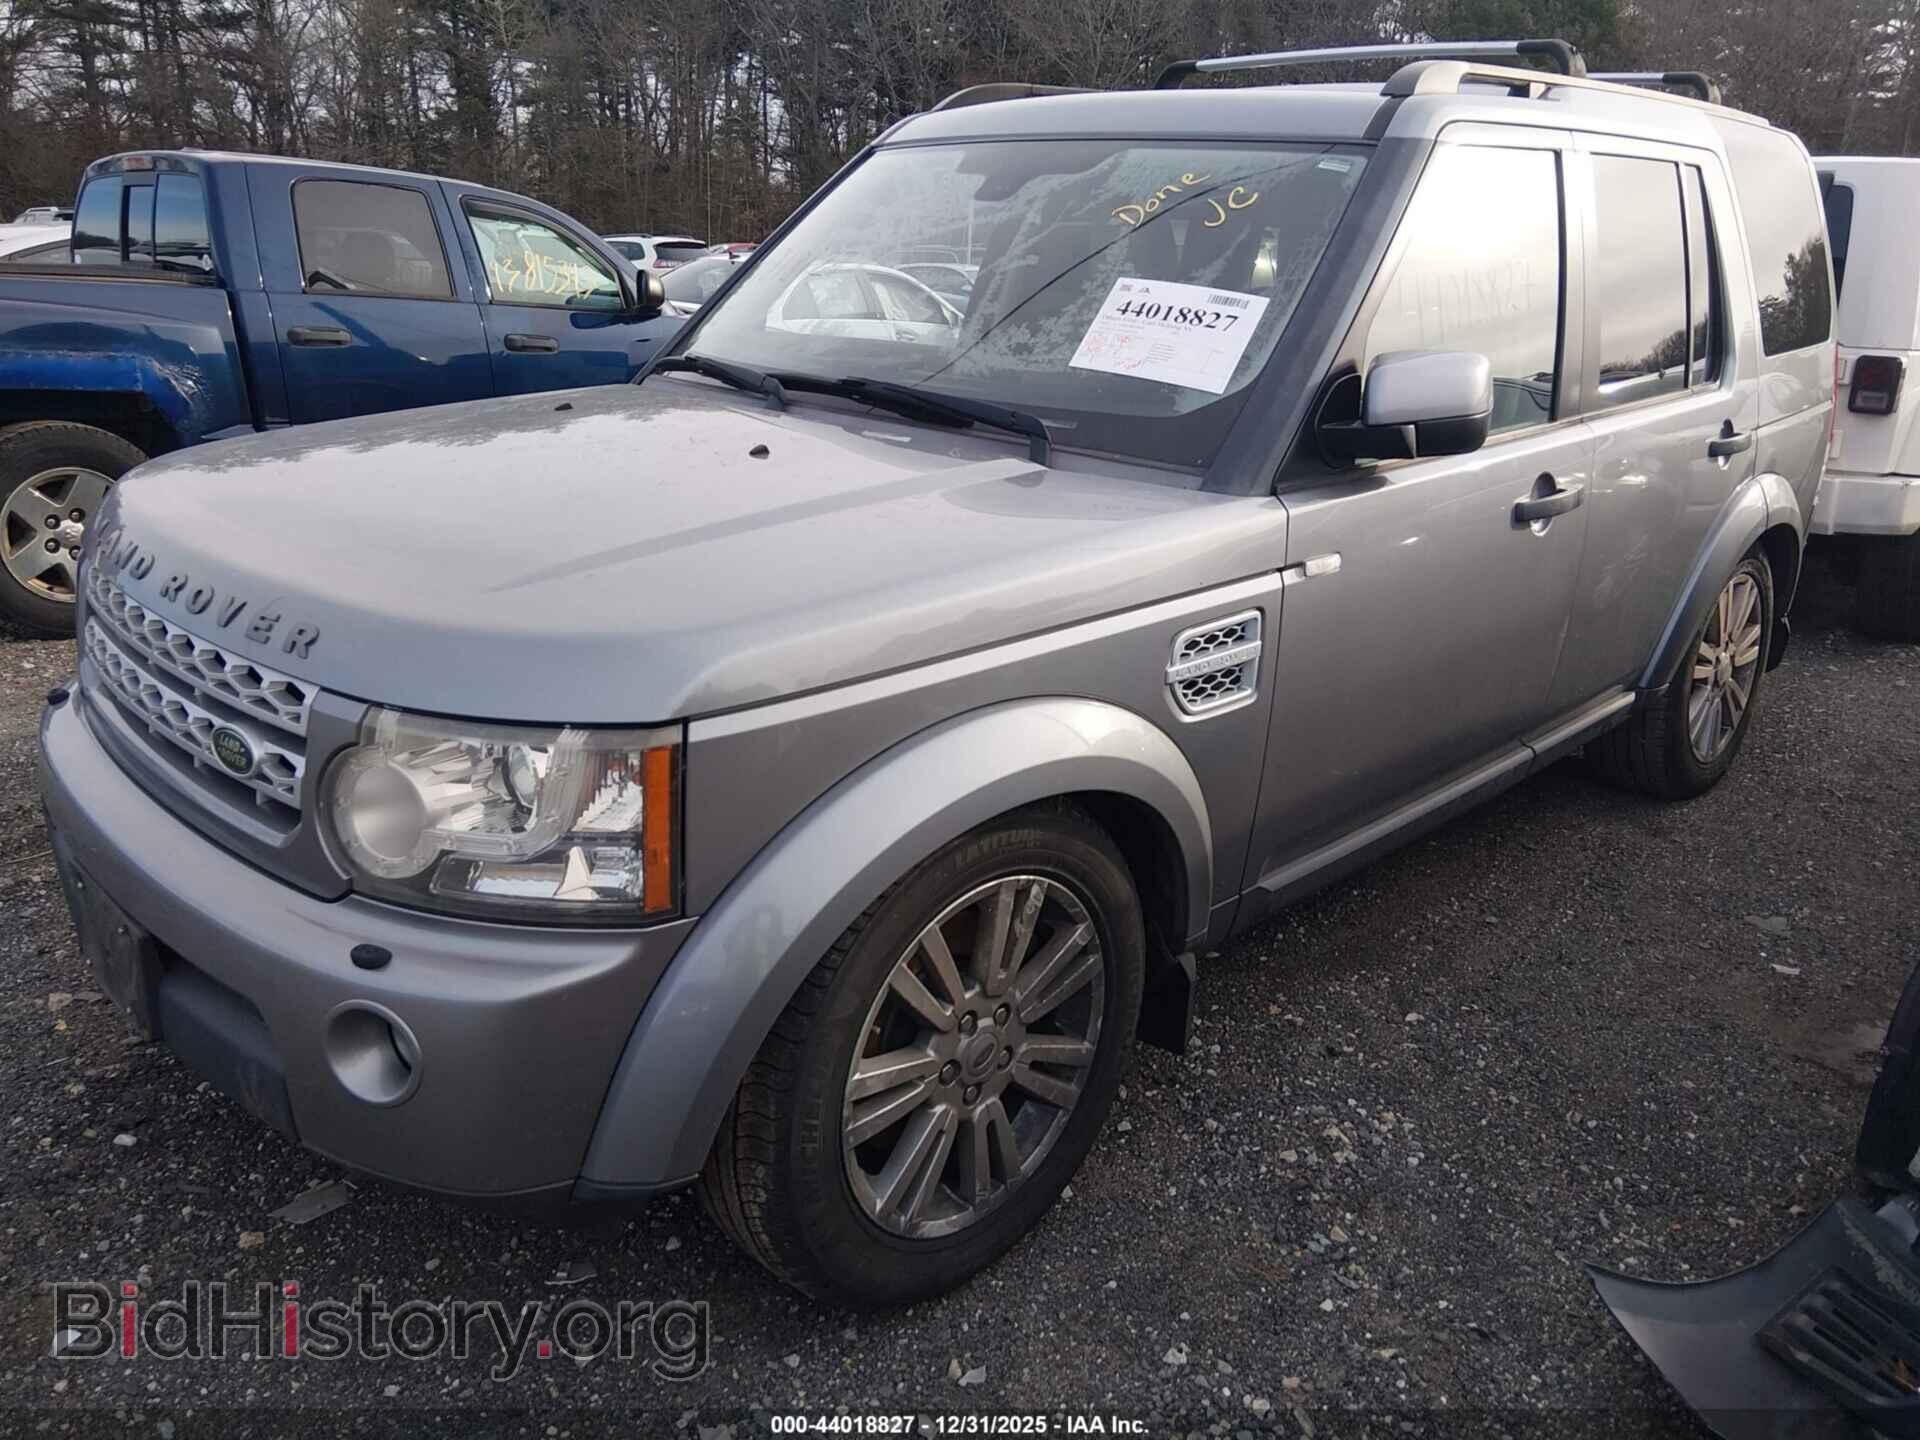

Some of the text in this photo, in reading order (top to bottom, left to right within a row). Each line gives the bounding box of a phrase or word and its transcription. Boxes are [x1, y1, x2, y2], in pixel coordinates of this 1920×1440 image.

[1112, 172, 1210, 227] Done
[1116, 299, 1239, 332] 44018827
[160, 573, 321, 660] ROVER
